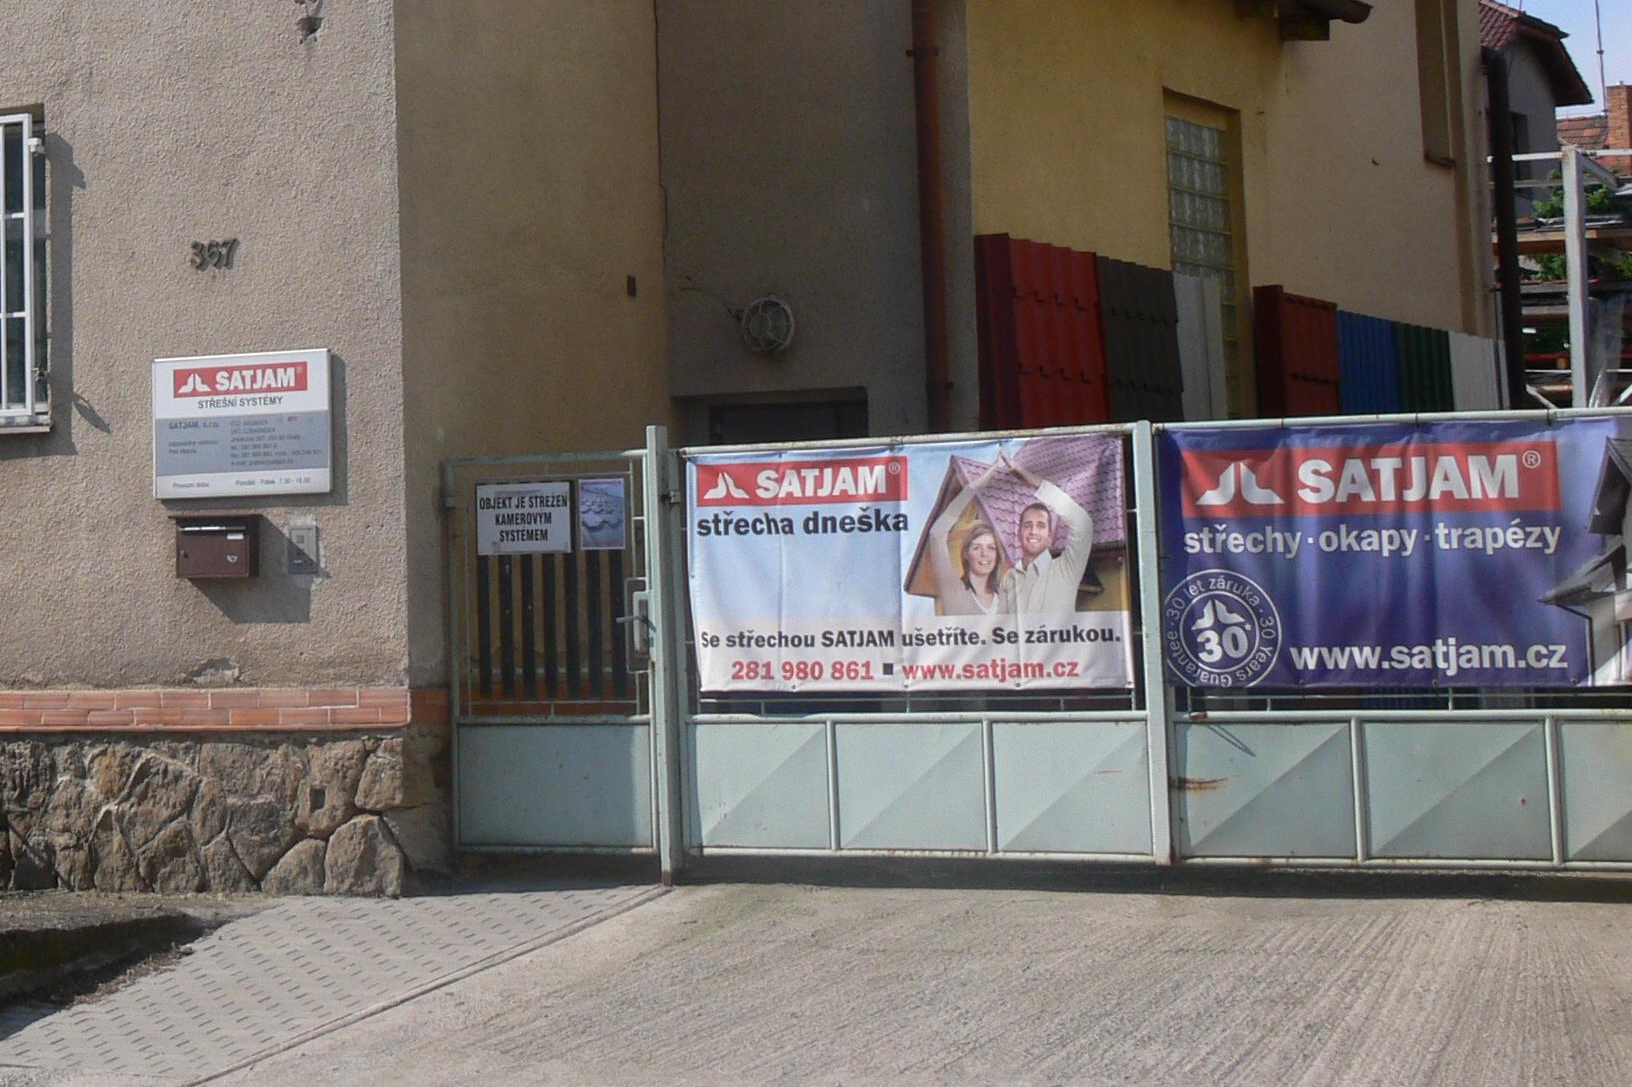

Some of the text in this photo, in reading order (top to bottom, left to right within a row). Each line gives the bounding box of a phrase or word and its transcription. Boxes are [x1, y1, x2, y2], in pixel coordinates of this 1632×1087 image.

[197, 394, 284, 410] STŘEŠNÍ SYSTÉMY
[479, 497, 512, 510] OBJEKT
[515, 496, 526, 509] JE
[696, 506, 909, 537] střecha dneška
[1183, 517, 1562, 559] střechy okapy trapézy
[1208, 575, 1260, 607] záruka
[1259, 616, 1276, 639] 30
[701, 624, 1121, 649] Se střechou SATJAM ušetříte. Se zárukou.
[731, 657, 1080, 683] 281 980 861 www.satjam.cz
[1289, 637, 1569, 676] www.satjam.cz
